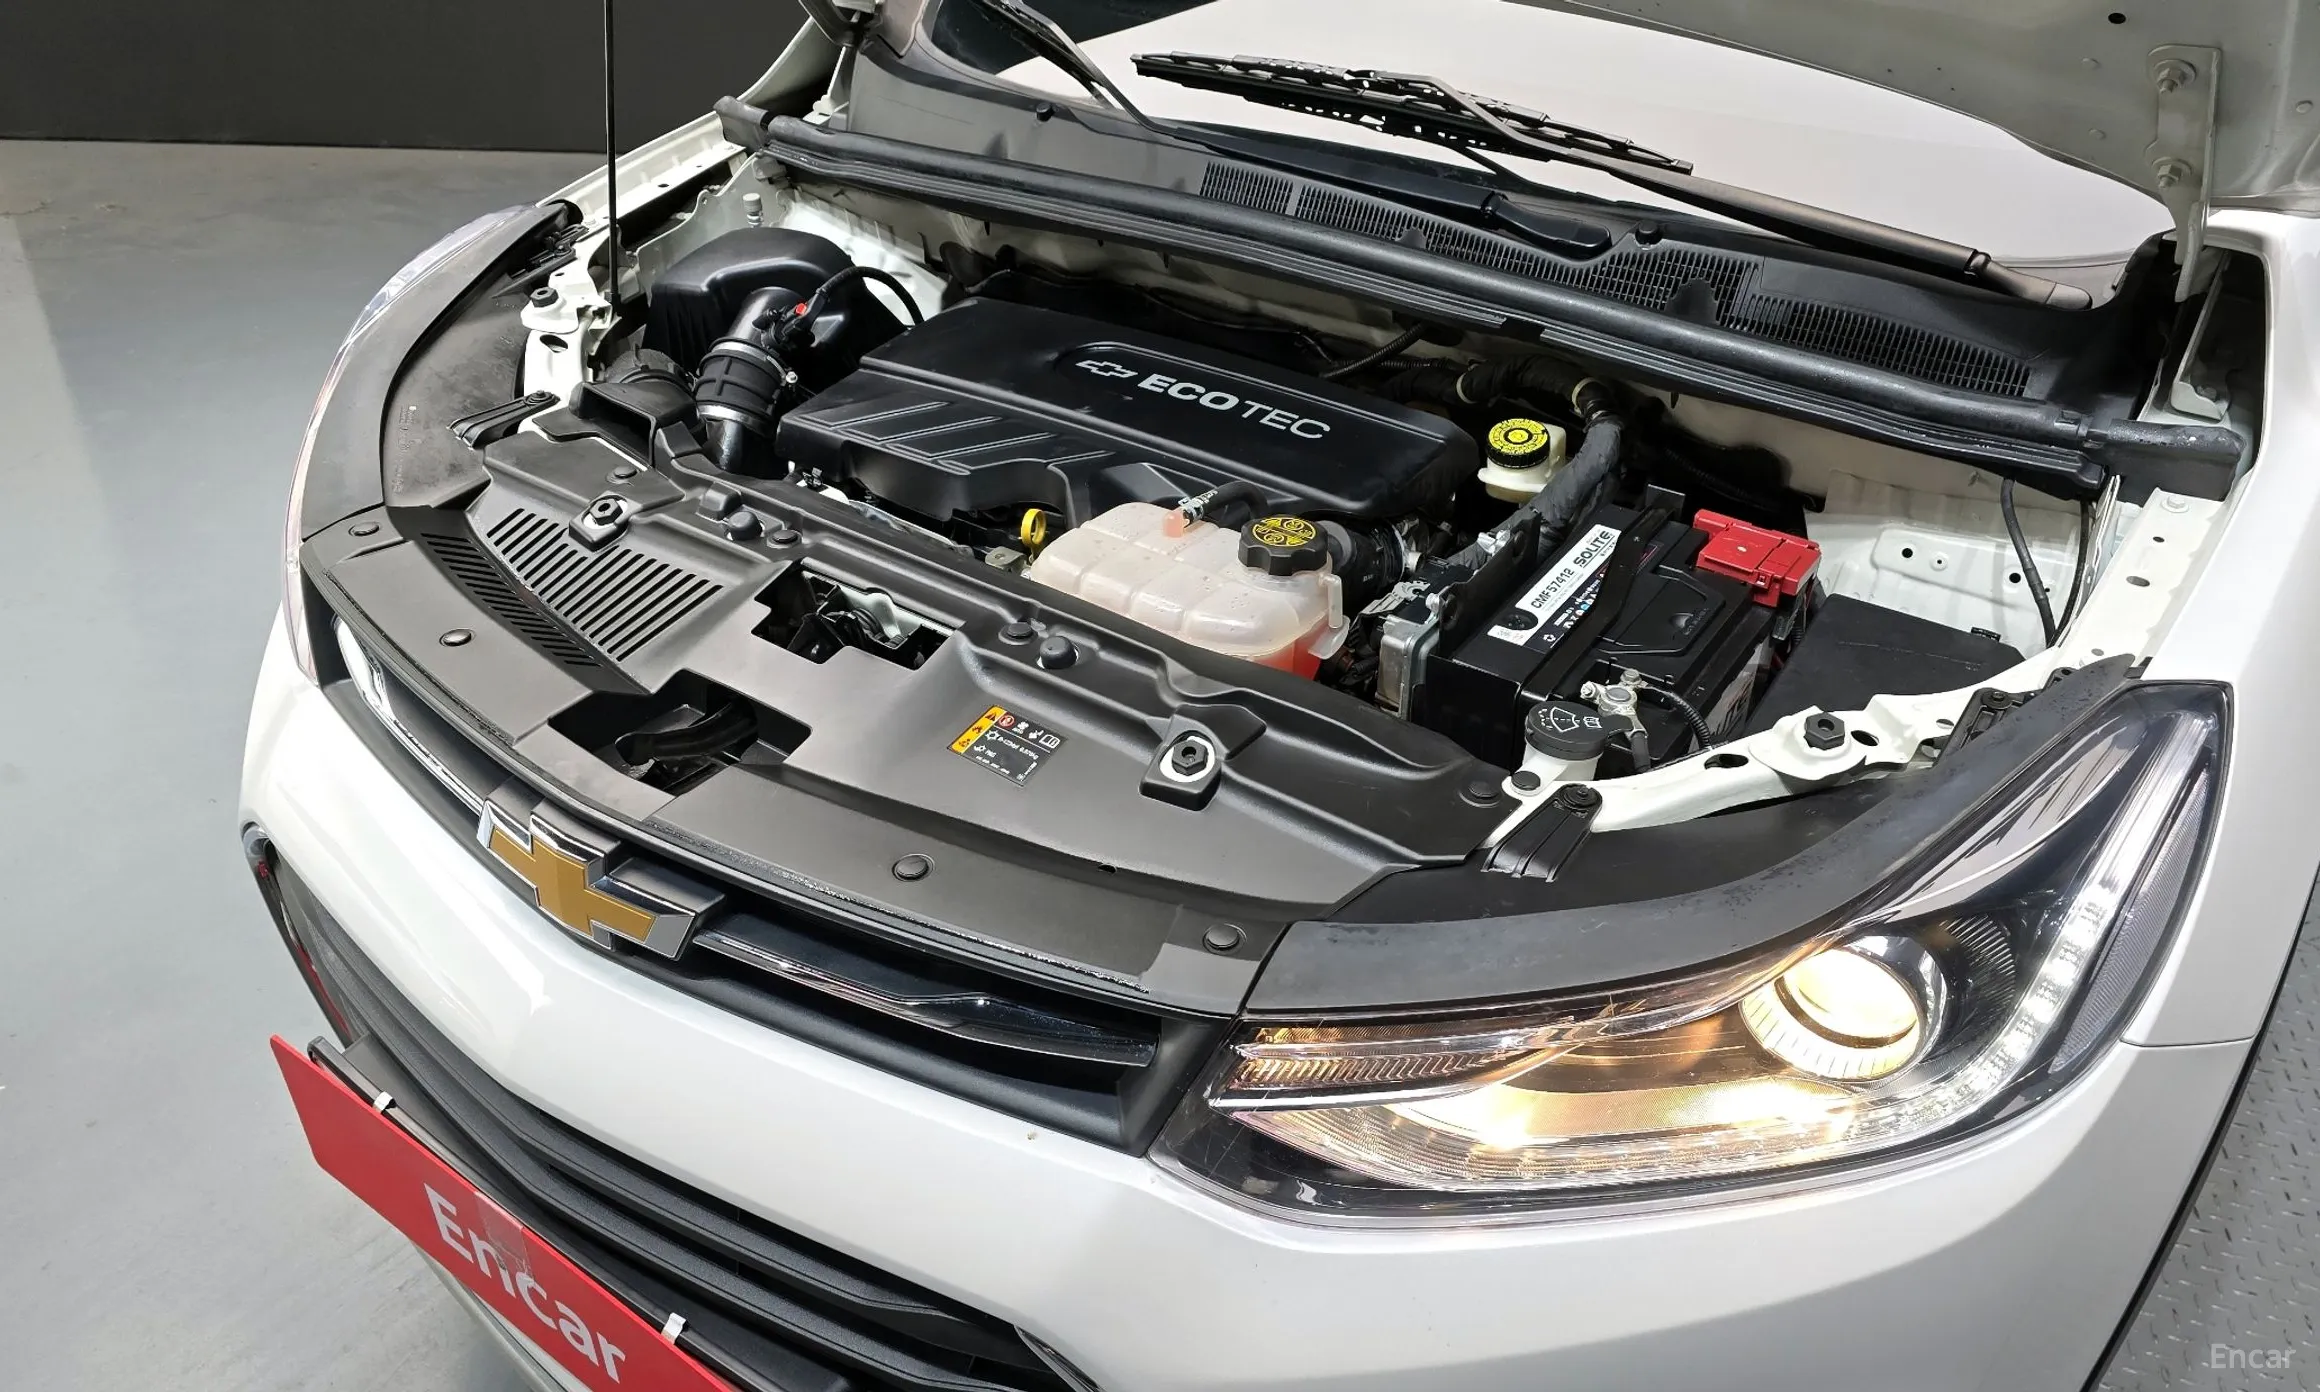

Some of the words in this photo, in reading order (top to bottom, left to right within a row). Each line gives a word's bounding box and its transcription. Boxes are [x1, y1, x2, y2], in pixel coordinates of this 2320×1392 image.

[1137, 373, 1331, 439] ECOTEC
[1530, 567, 1575, 609] CMF57412
[1573, 530, 1611, 567] SOLITE
[423, 1182, 626, 1384] Encar
